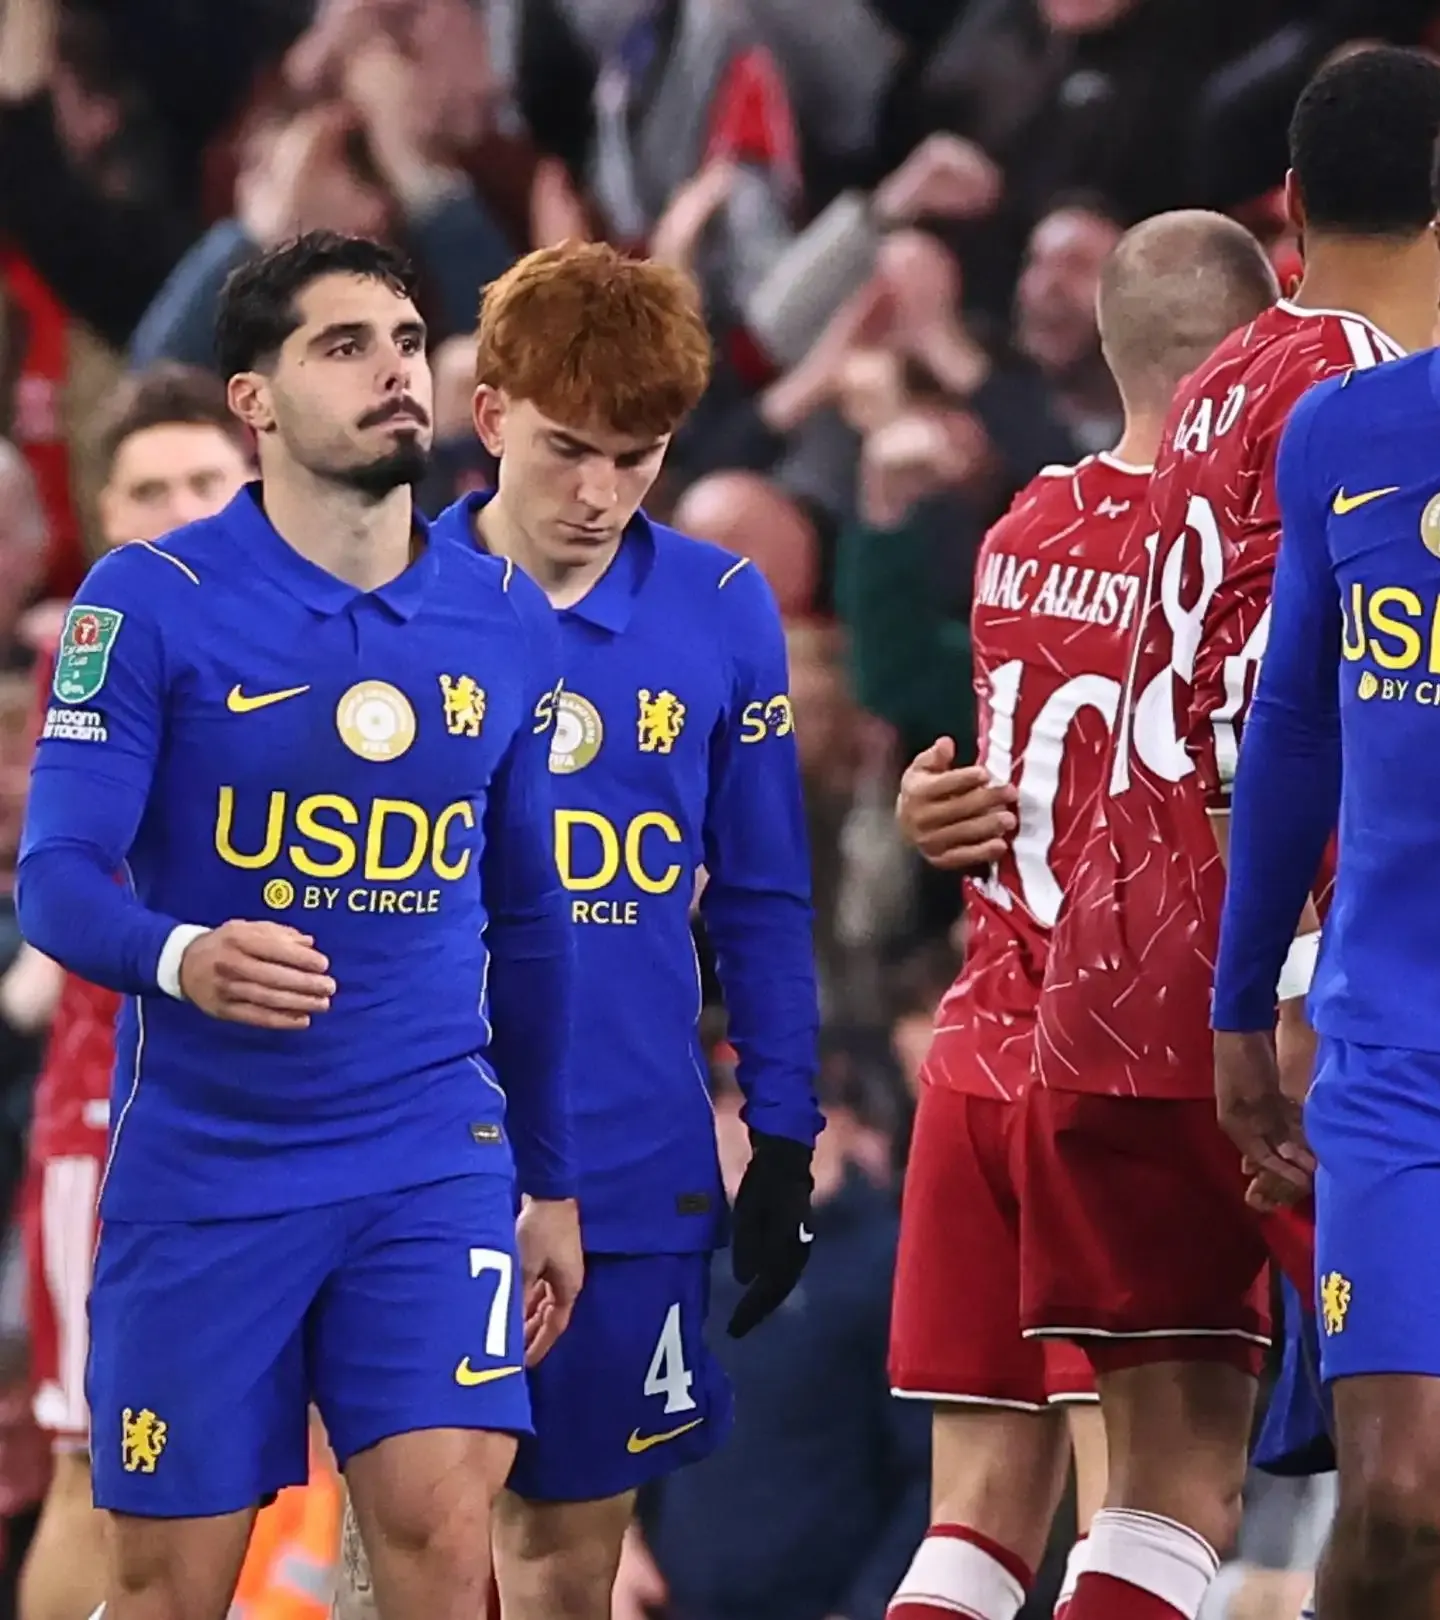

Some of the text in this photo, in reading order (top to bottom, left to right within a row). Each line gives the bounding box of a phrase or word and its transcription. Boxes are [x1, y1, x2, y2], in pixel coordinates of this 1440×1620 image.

[1030, 563, 1141, 630] ALLIST
[1380, 677, 1410, 701] BY
[214, 785, 476, 881] USDC
[553, 808, 683, 895] DC
[303, 886, 441, 914] BY CIRCLE
[571, 900, 640, 925] RCLE
[469, 1247, 513, 1358] 7
[643, 1302, 697, 1414] 4
